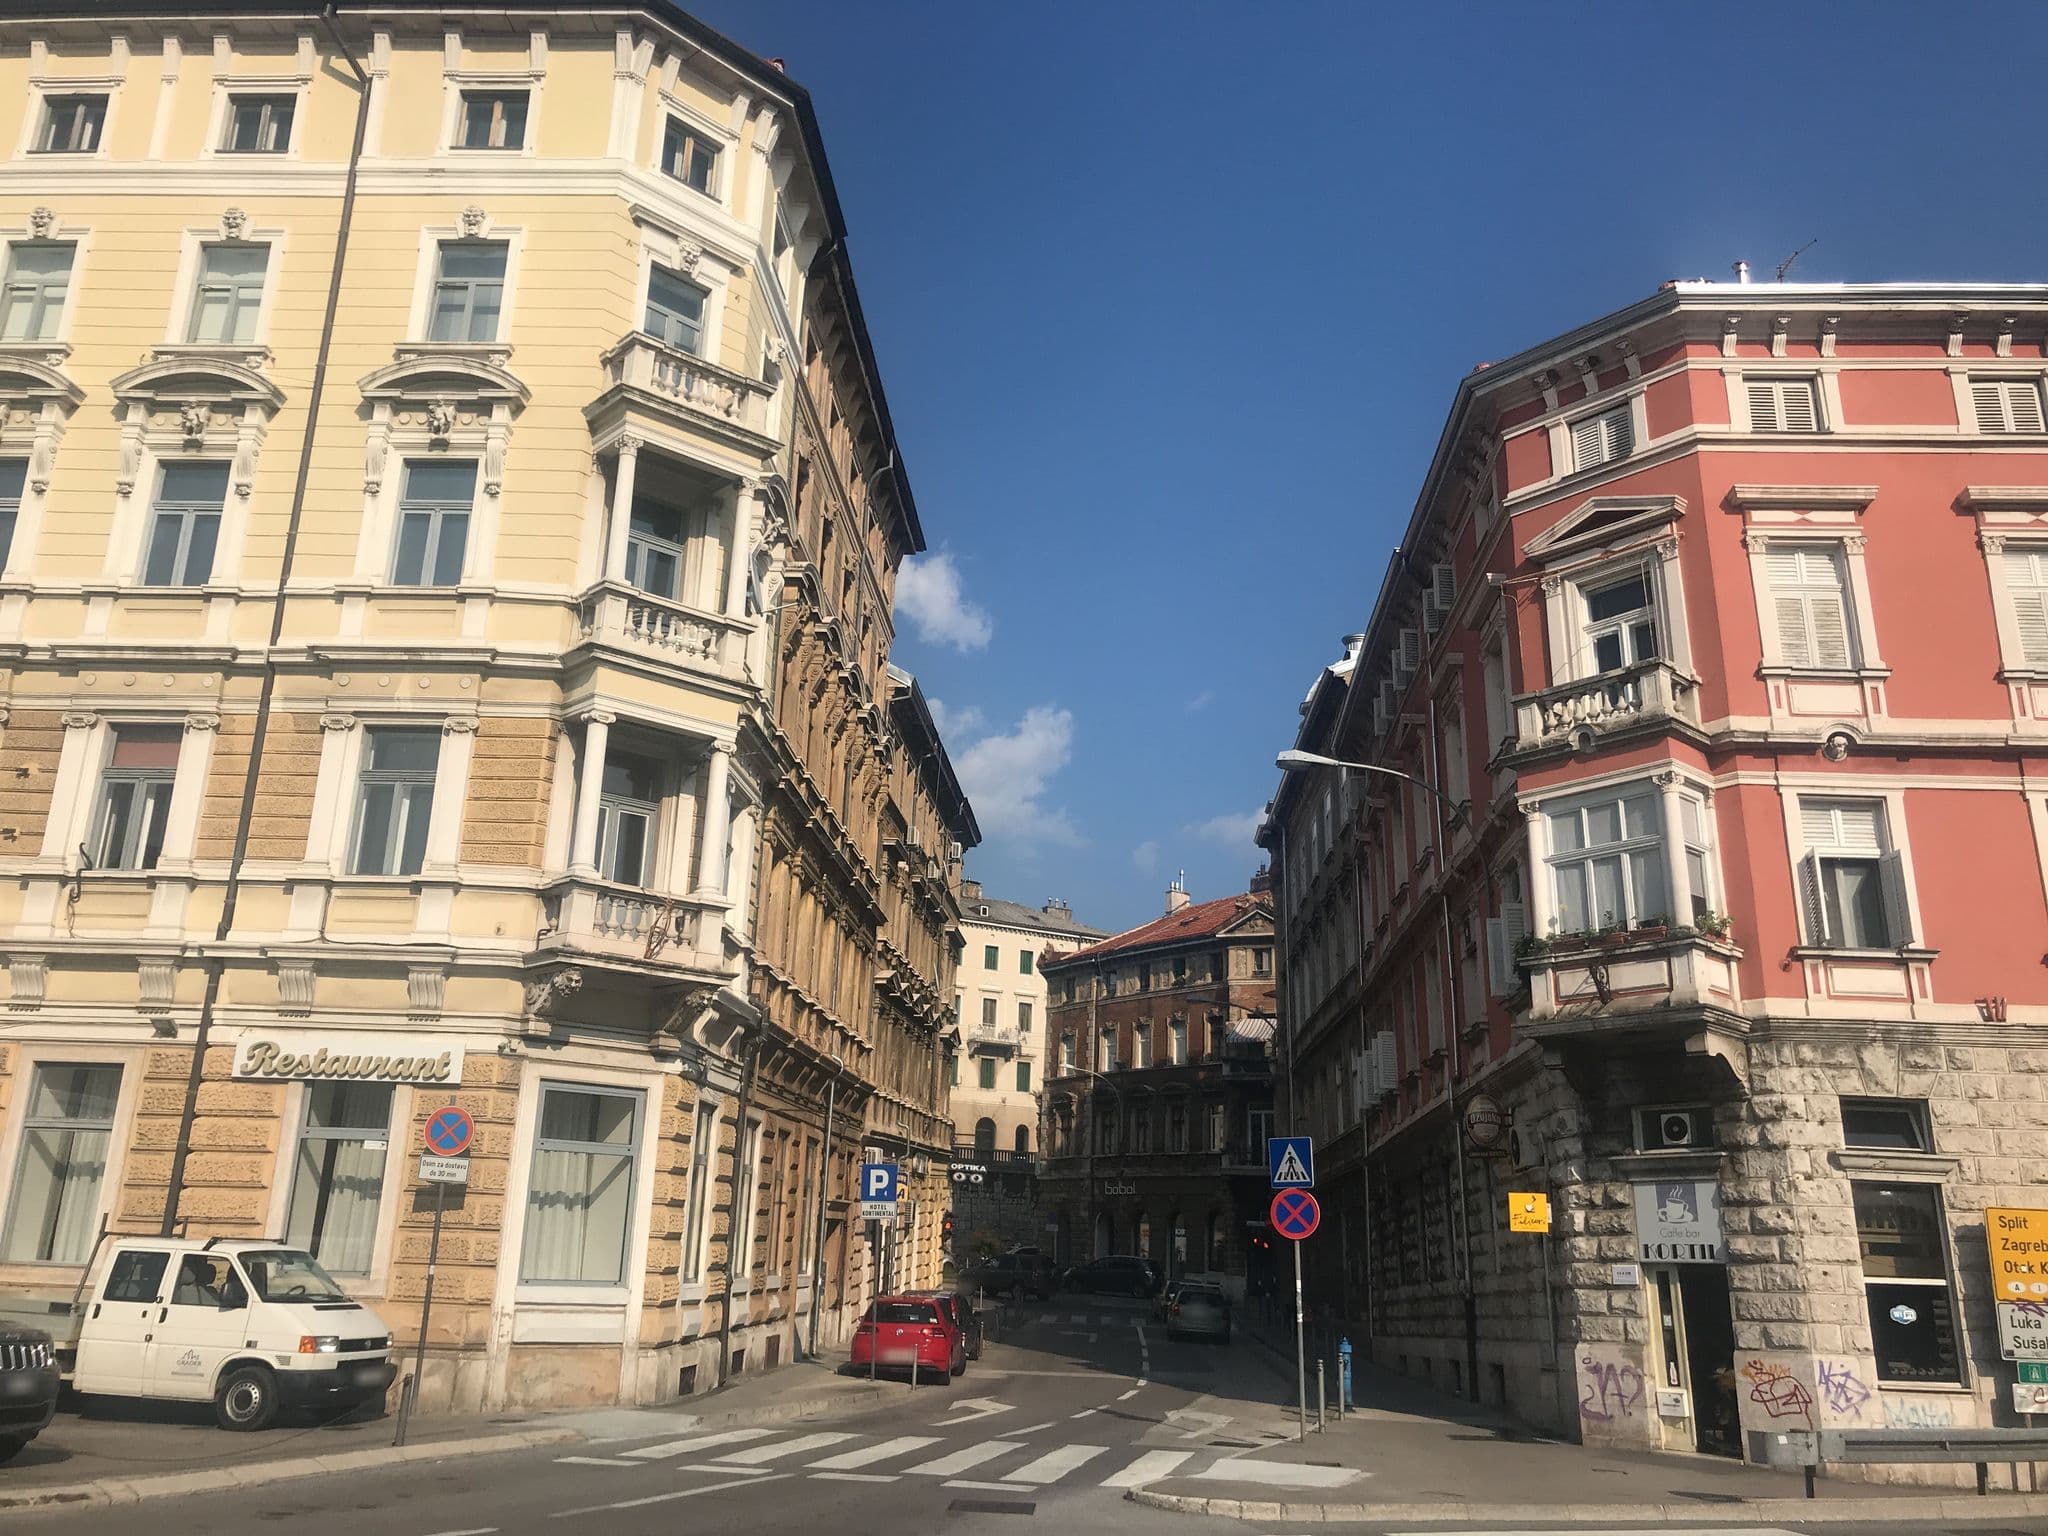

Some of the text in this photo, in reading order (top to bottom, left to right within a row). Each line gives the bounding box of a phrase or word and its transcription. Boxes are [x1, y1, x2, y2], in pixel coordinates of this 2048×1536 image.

[240, 1041, 452, 1082] Restaurant
[422, 1160, 436, 1168] Osim
[445, 1162, 467, 1170] dostavu
[950, 1163, 987, 1172] OPTIKA
[869, 1169, 889, 1196] P
[1998, 1215, 2029, 1231] Split
[1660, 1227, 1701, 1238] Caffe bar
[2010, 1315, 2041, 1329] Luka
